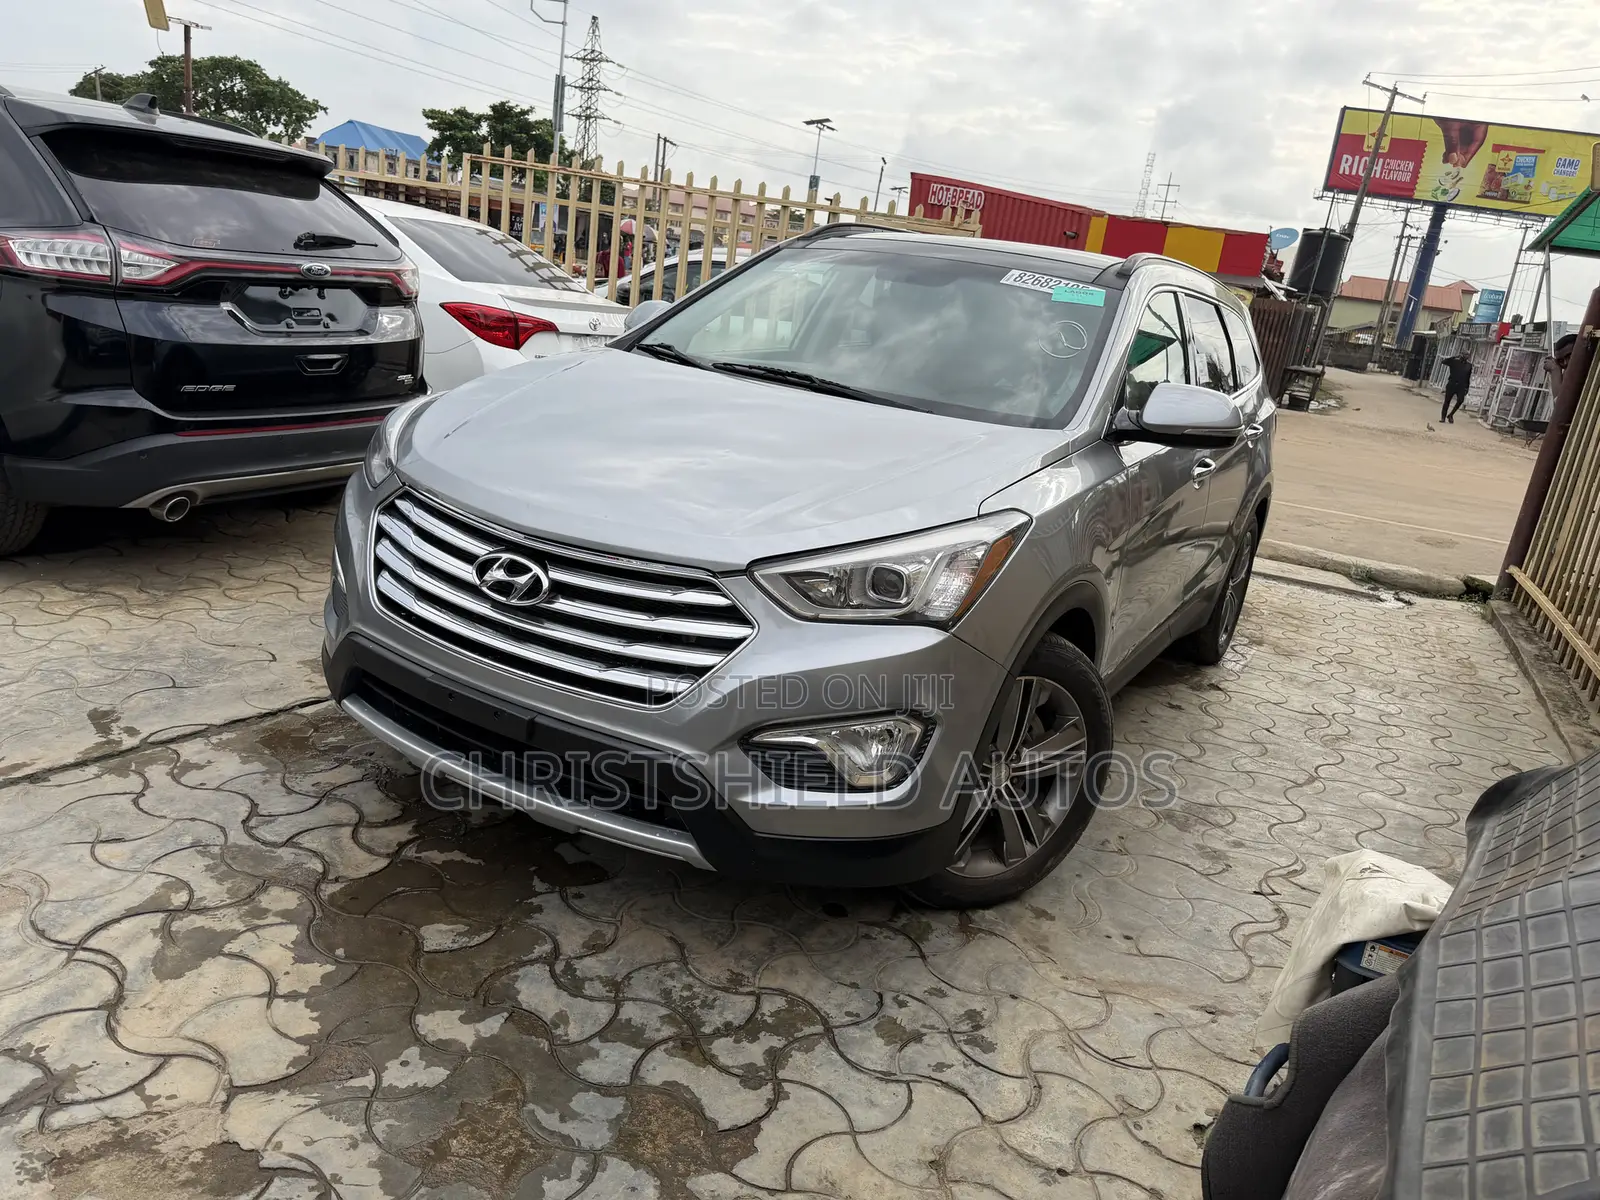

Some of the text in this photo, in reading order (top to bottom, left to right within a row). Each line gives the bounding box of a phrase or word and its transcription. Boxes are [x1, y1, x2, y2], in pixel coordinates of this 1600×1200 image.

[1338, 154, 1383, 178] RICH
[1384, 158, 1414, 172] CHICKEN
[1381, 169, 1412, 182] FLAVOUR
[180, 384, 237, 392] EDGE
